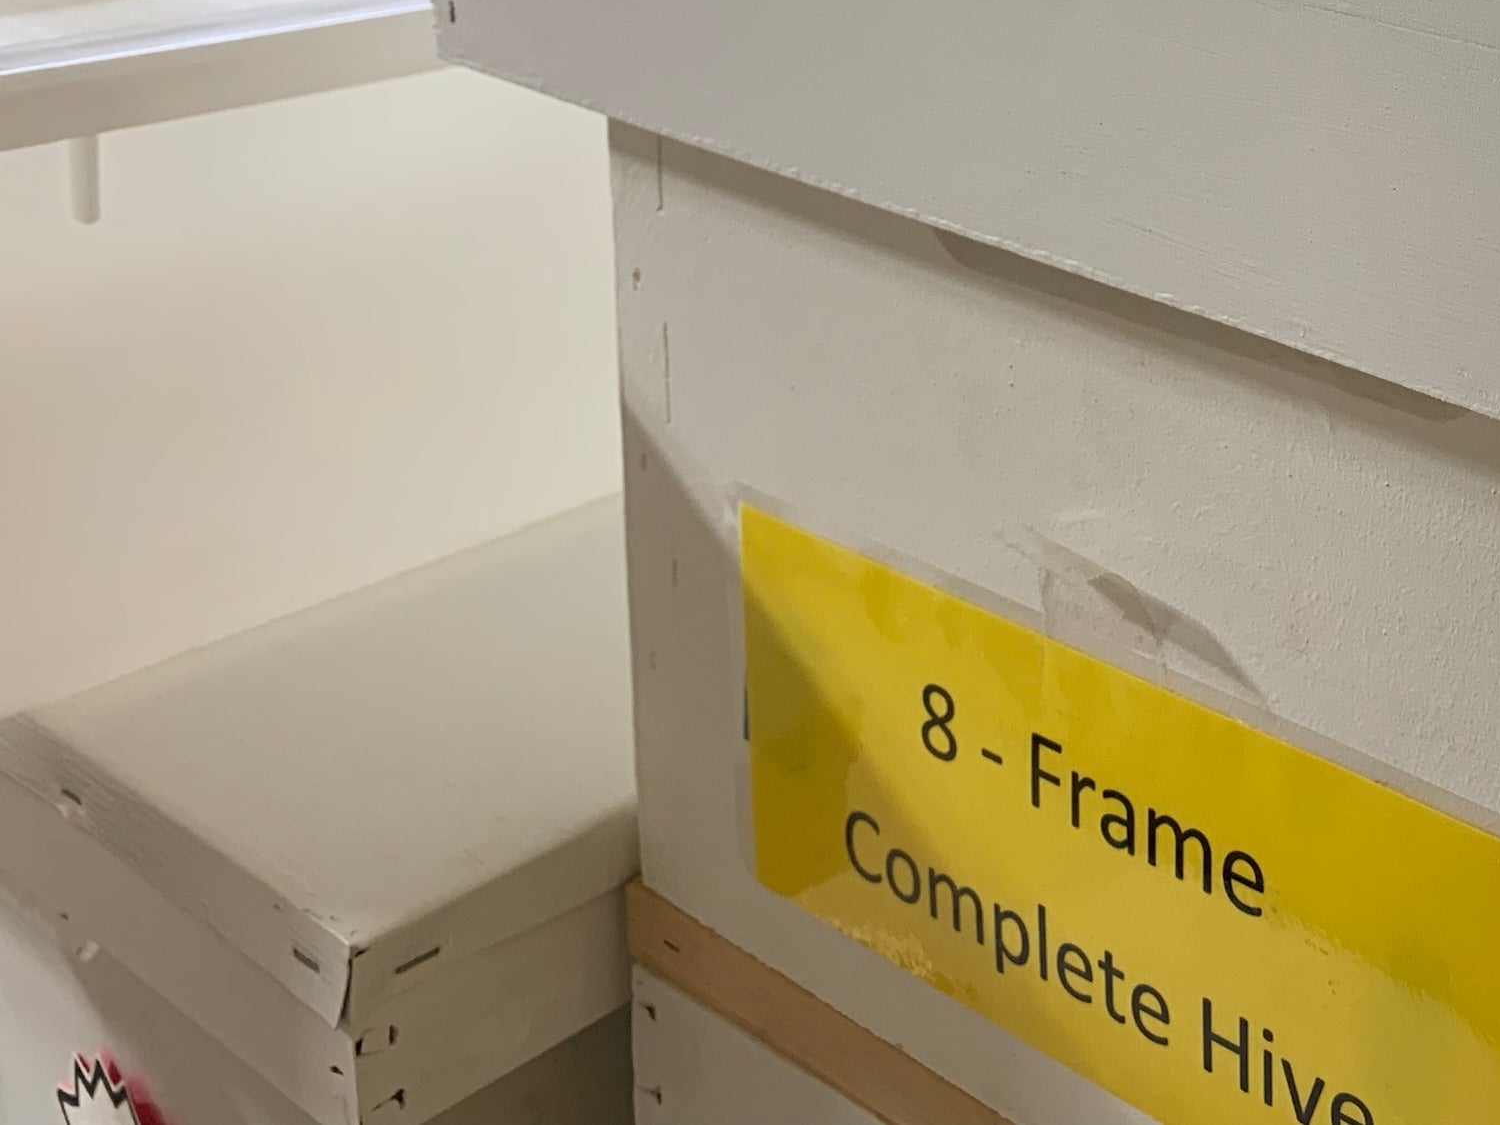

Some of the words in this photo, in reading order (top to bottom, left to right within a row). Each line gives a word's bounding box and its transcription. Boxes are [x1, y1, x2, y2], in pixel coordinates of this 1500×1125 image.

[921, 683, 958, 762] 8
[1030, 732, 1265, 917] Frame
[844, 810, 1171, 1046] Complete
